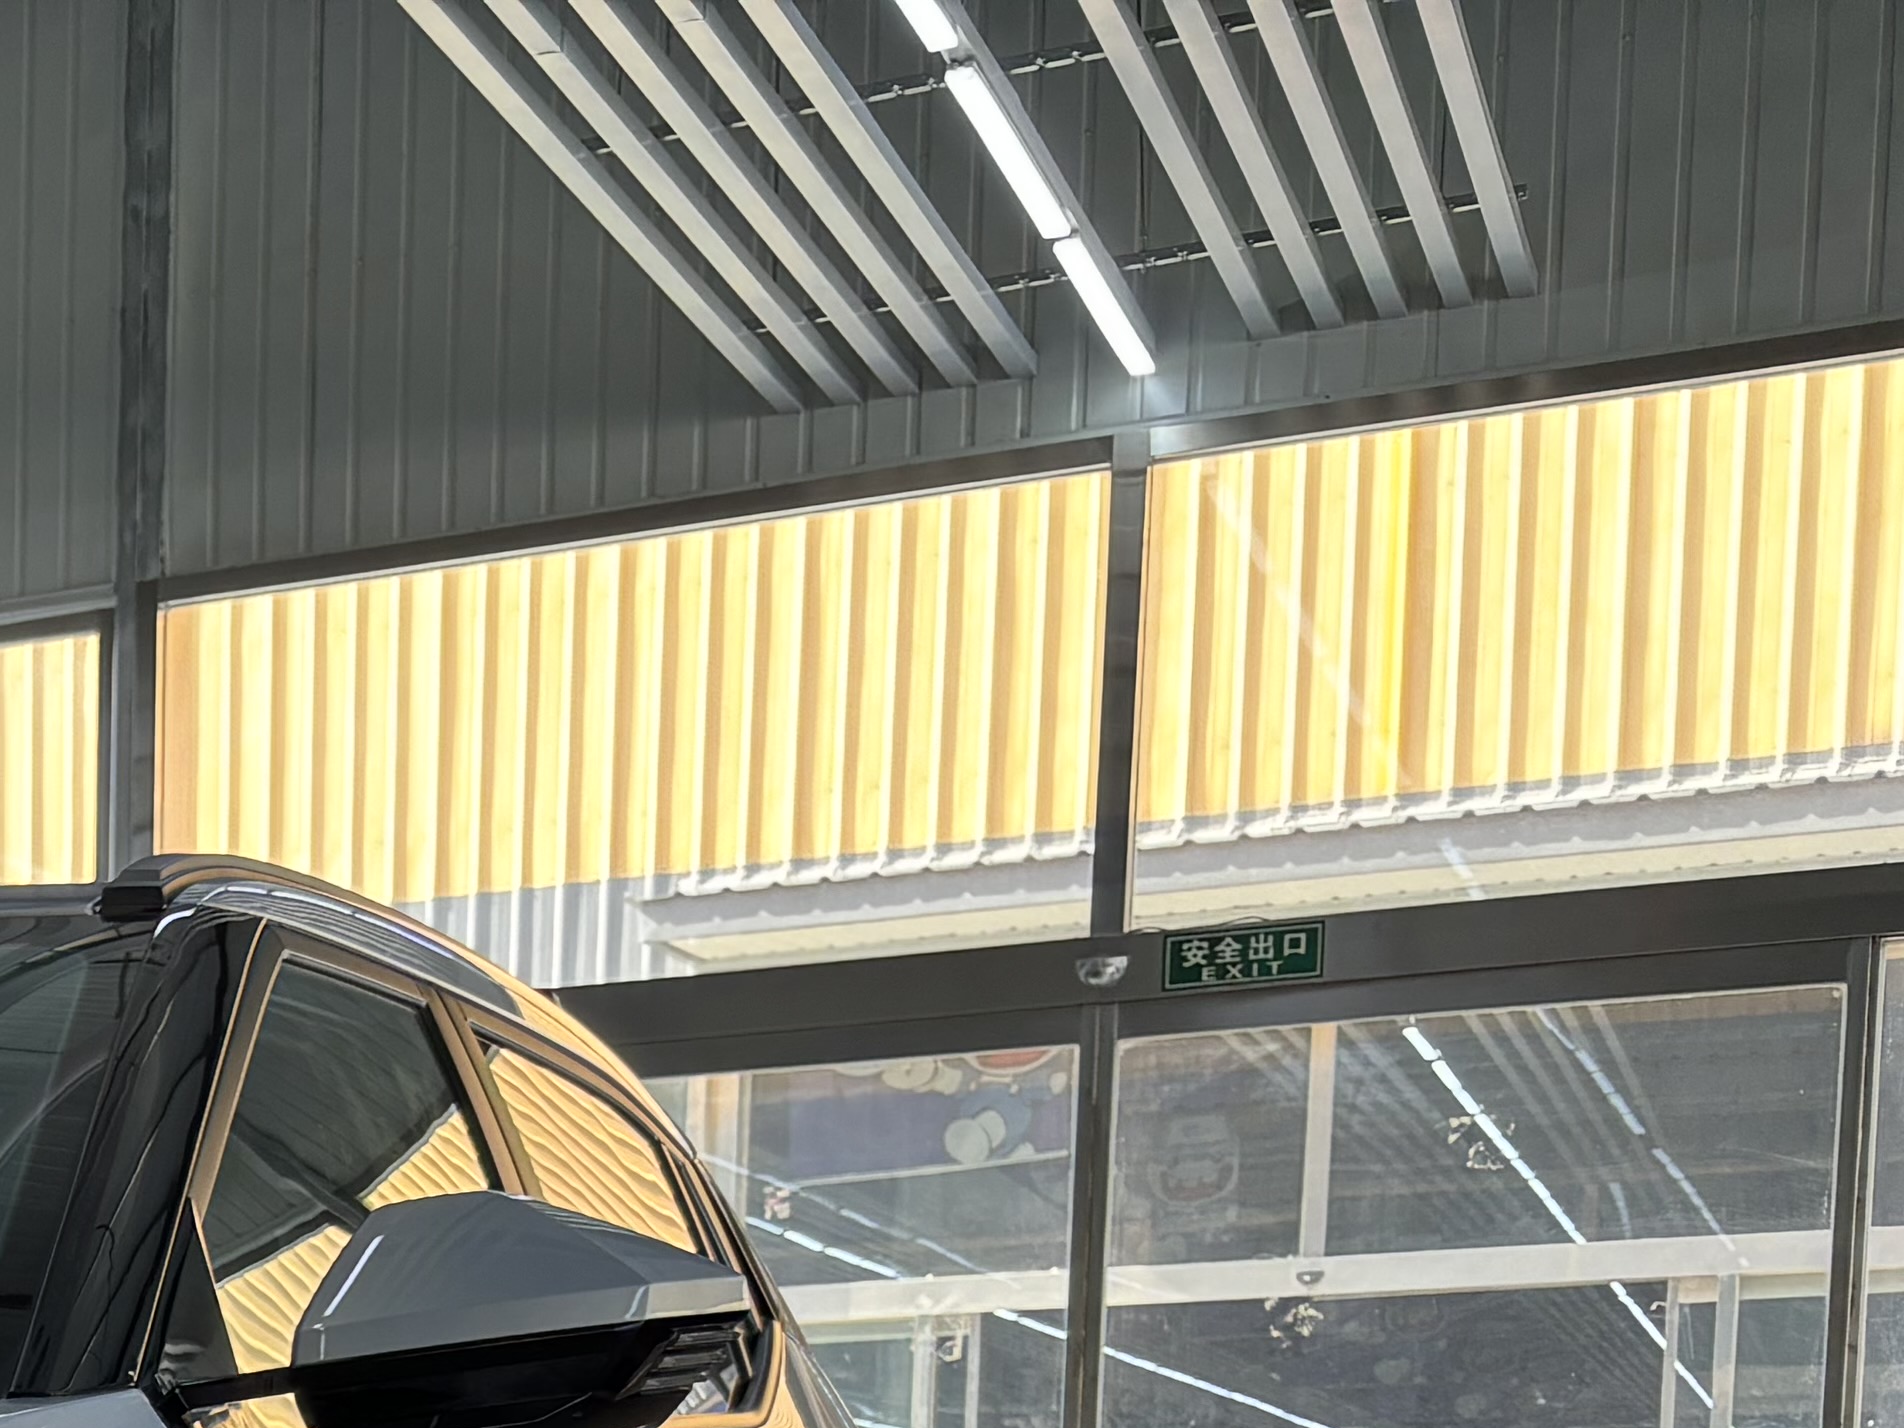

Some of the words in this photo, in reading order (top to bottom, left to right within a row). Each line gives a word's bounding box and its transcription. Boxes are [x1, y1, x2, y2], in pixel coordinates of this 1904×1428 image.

[1180, 932, 1307, 968] 安全出口
[1201, 960, 1284, 982] EXIT
